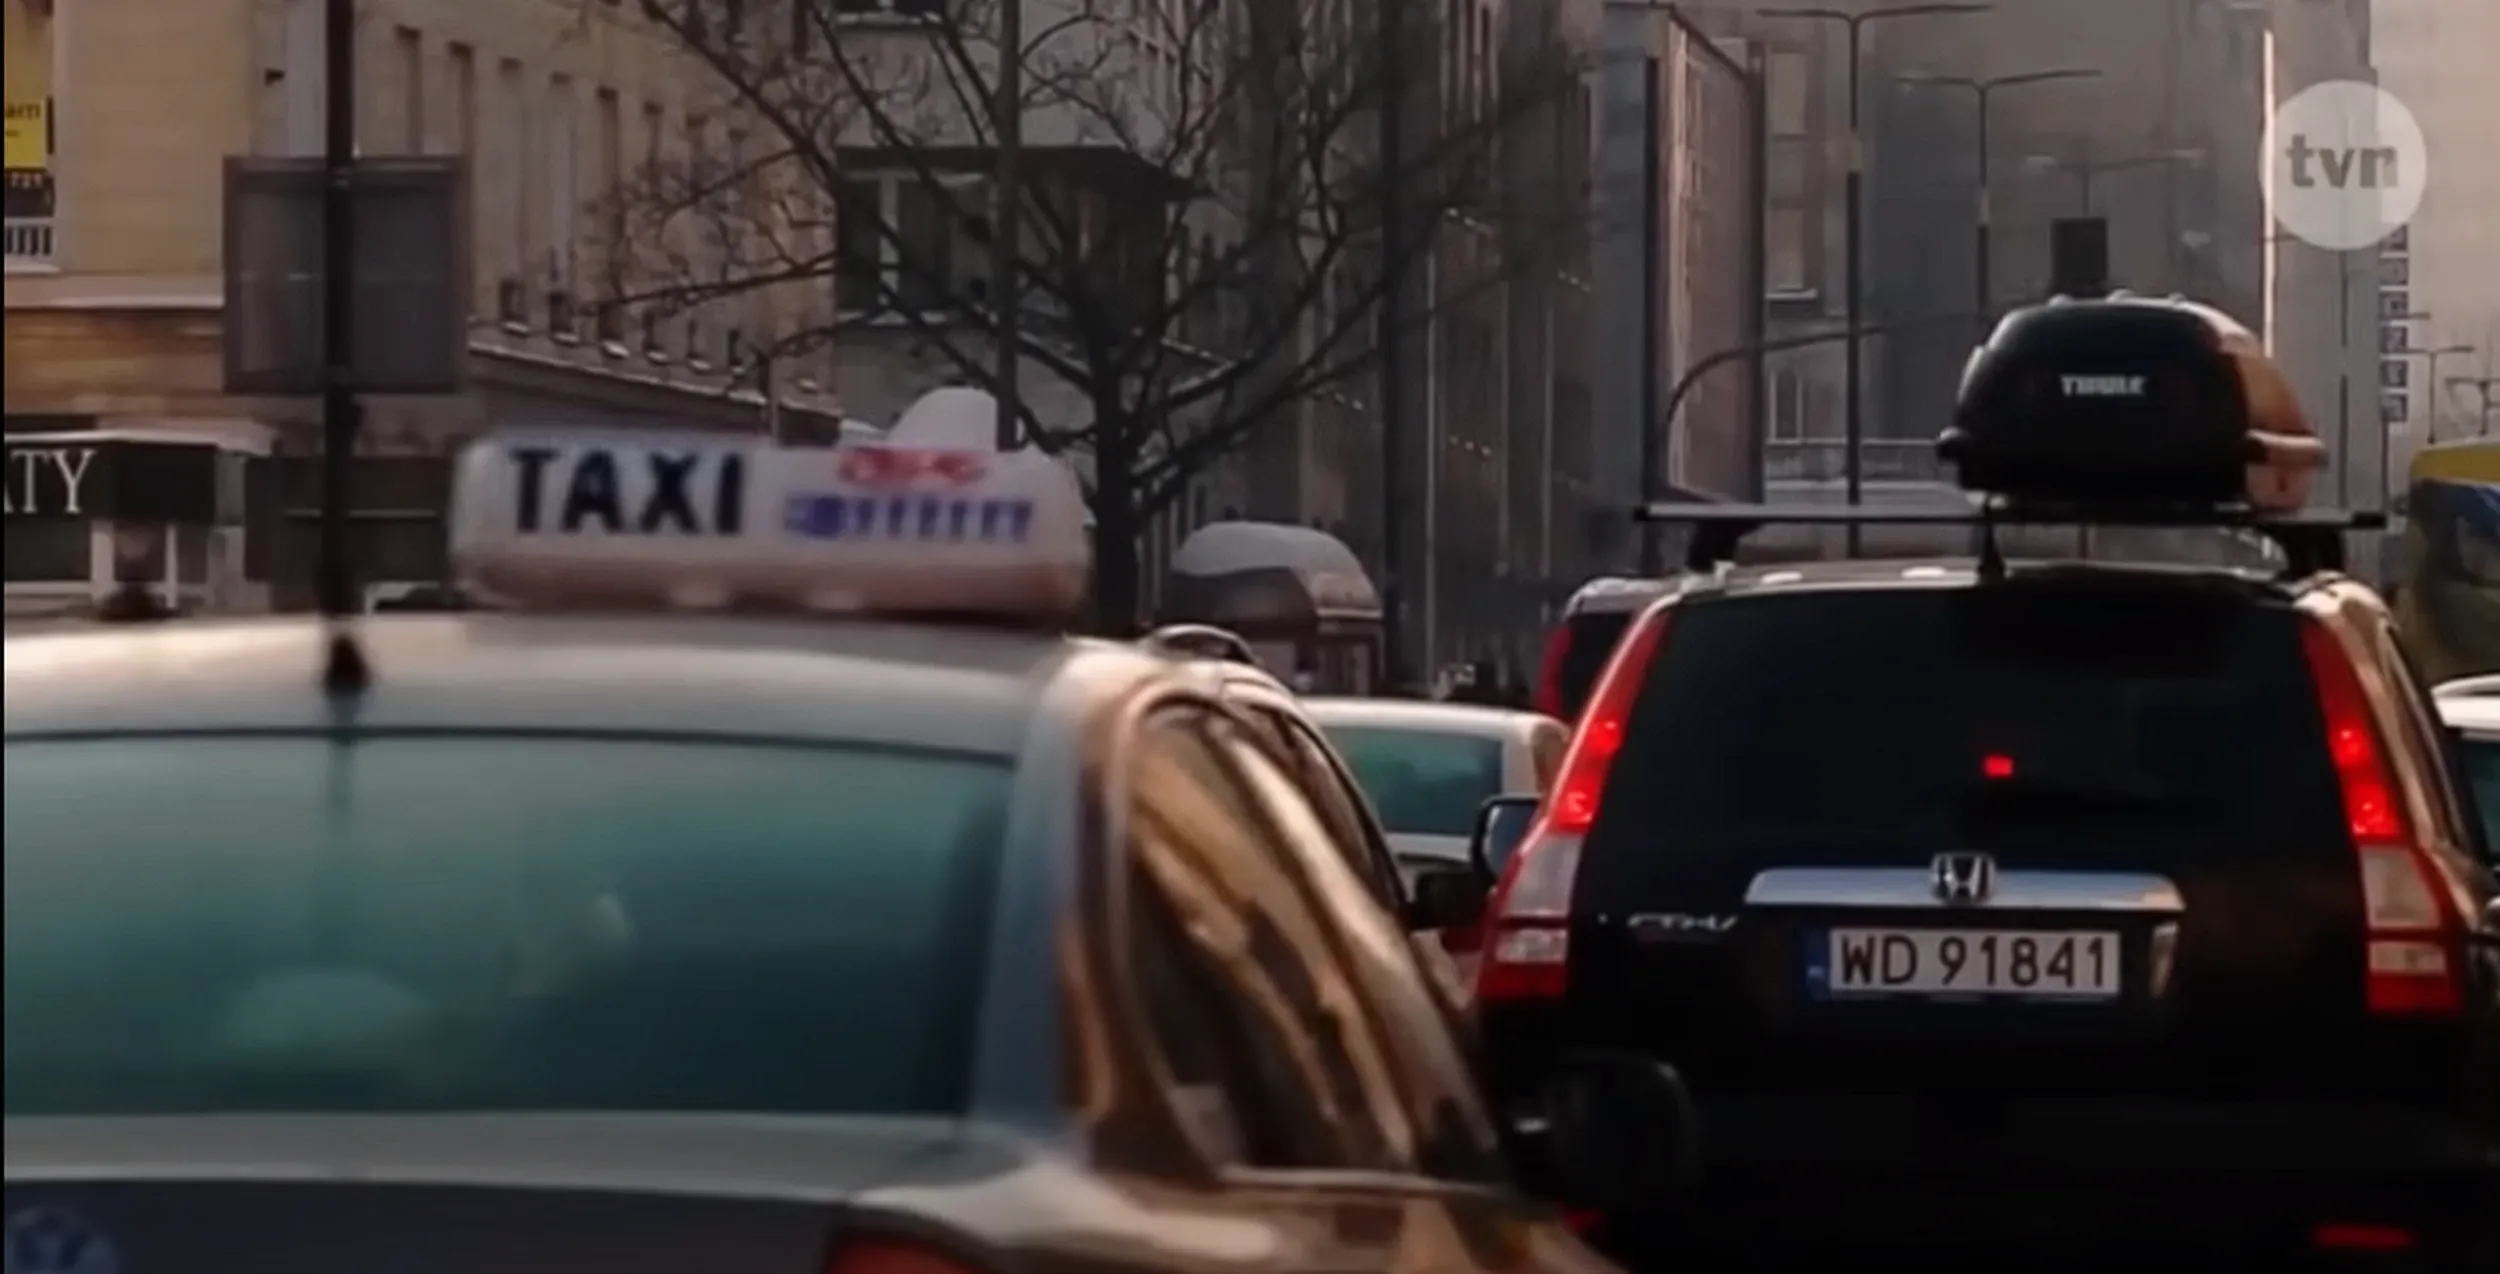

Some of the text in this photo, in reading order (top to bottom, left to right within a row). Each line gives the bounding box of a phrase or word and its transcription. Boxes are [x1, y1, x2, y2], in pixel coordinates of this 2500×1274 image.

[4, 448, 96, 514] TY
[511, 446, 745, 536] TAXI
[1841, 935, 2106, 988] WD 91841
